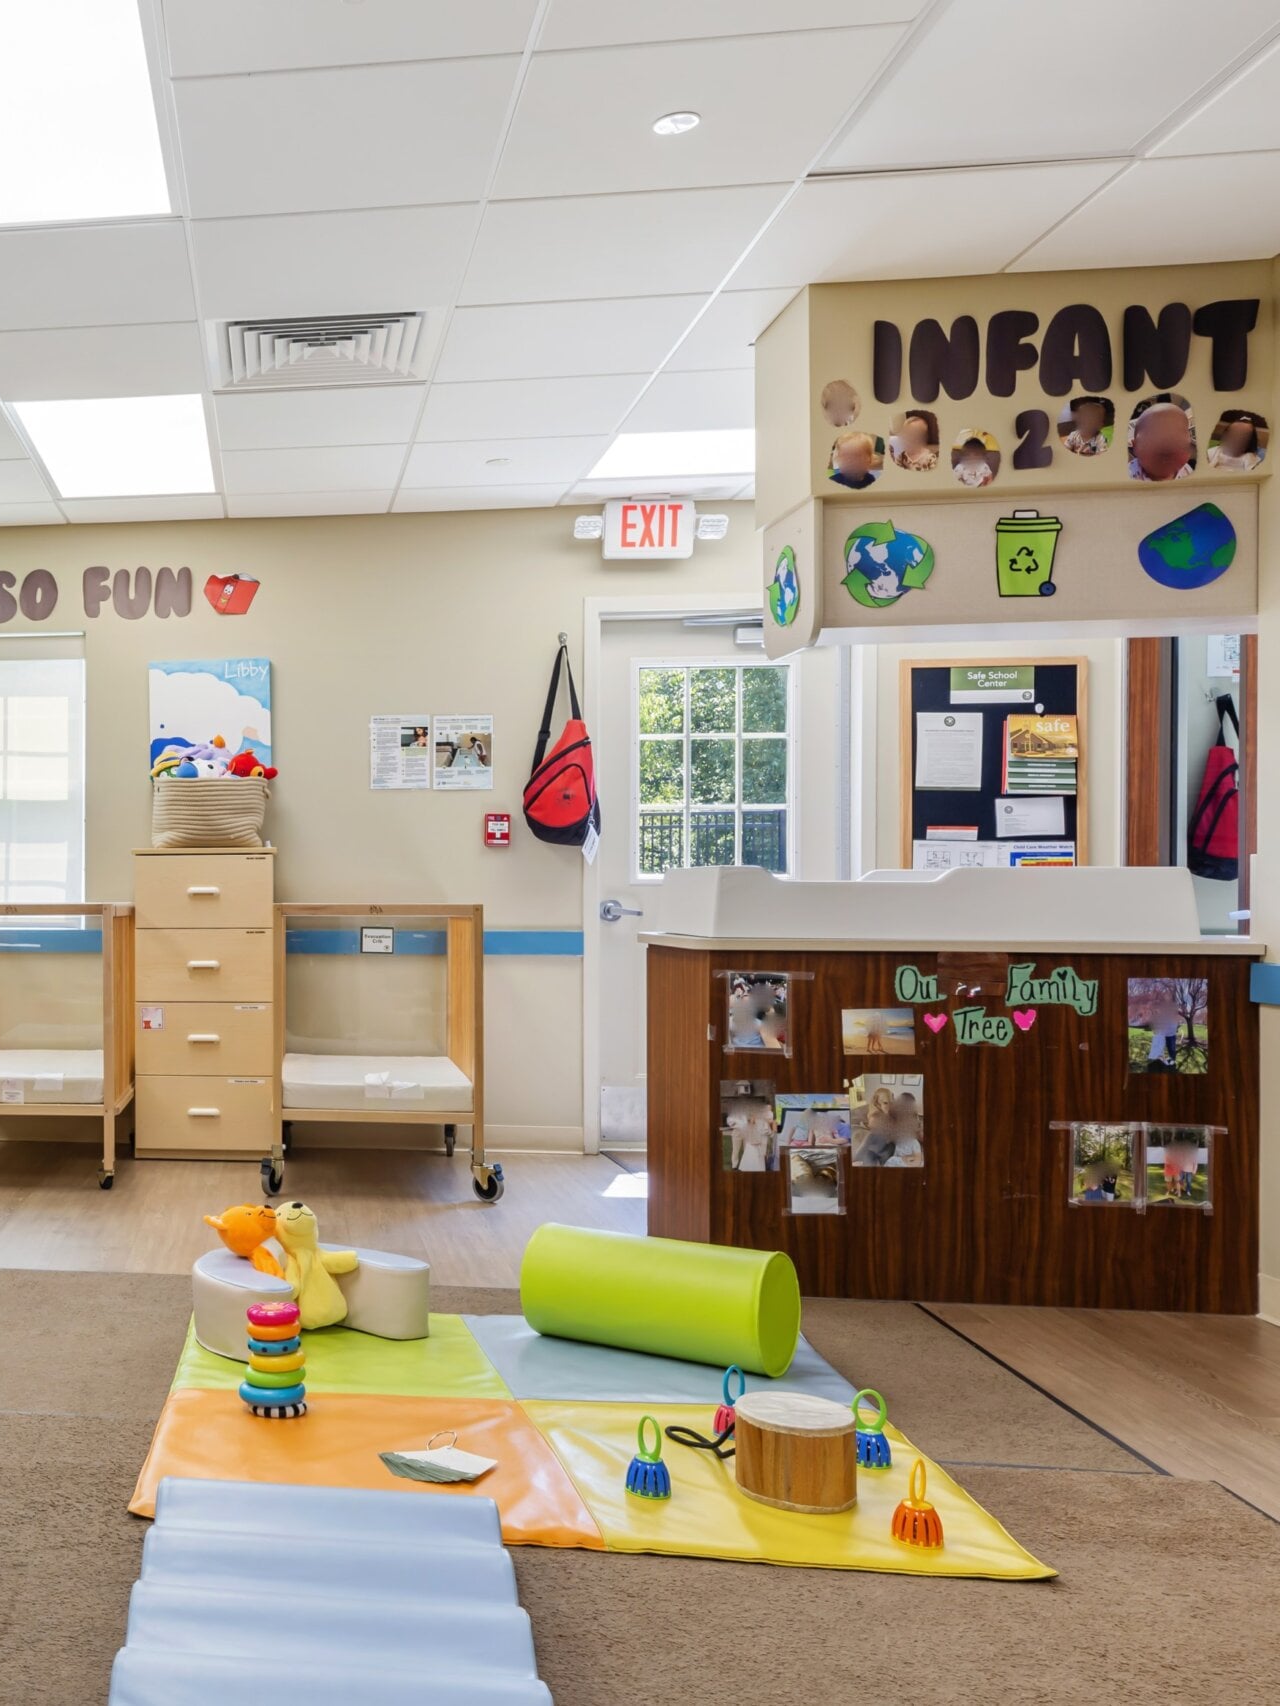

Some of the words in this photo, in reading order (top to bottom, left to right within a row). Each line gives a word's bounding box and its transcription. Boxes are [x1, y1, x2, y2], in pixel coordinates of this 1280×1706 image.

[873, 299, 1260, 404] INFANT
[1013, 409, 1054, 470] 2
[620, 504, 683, 548] EXIT
[83, 566, 192, 620] FUN
[224, 661, 269, 681] Libby
[967, 672, 986, 680] Safe
[988, 671, 1018, 680] School
[977, 680, 1007, 688] Center
[1036, 719, 1070, 733] safe
[1006, 964, 1096, 1014] Family
[954, 1007, 1008, 1041] Tree
